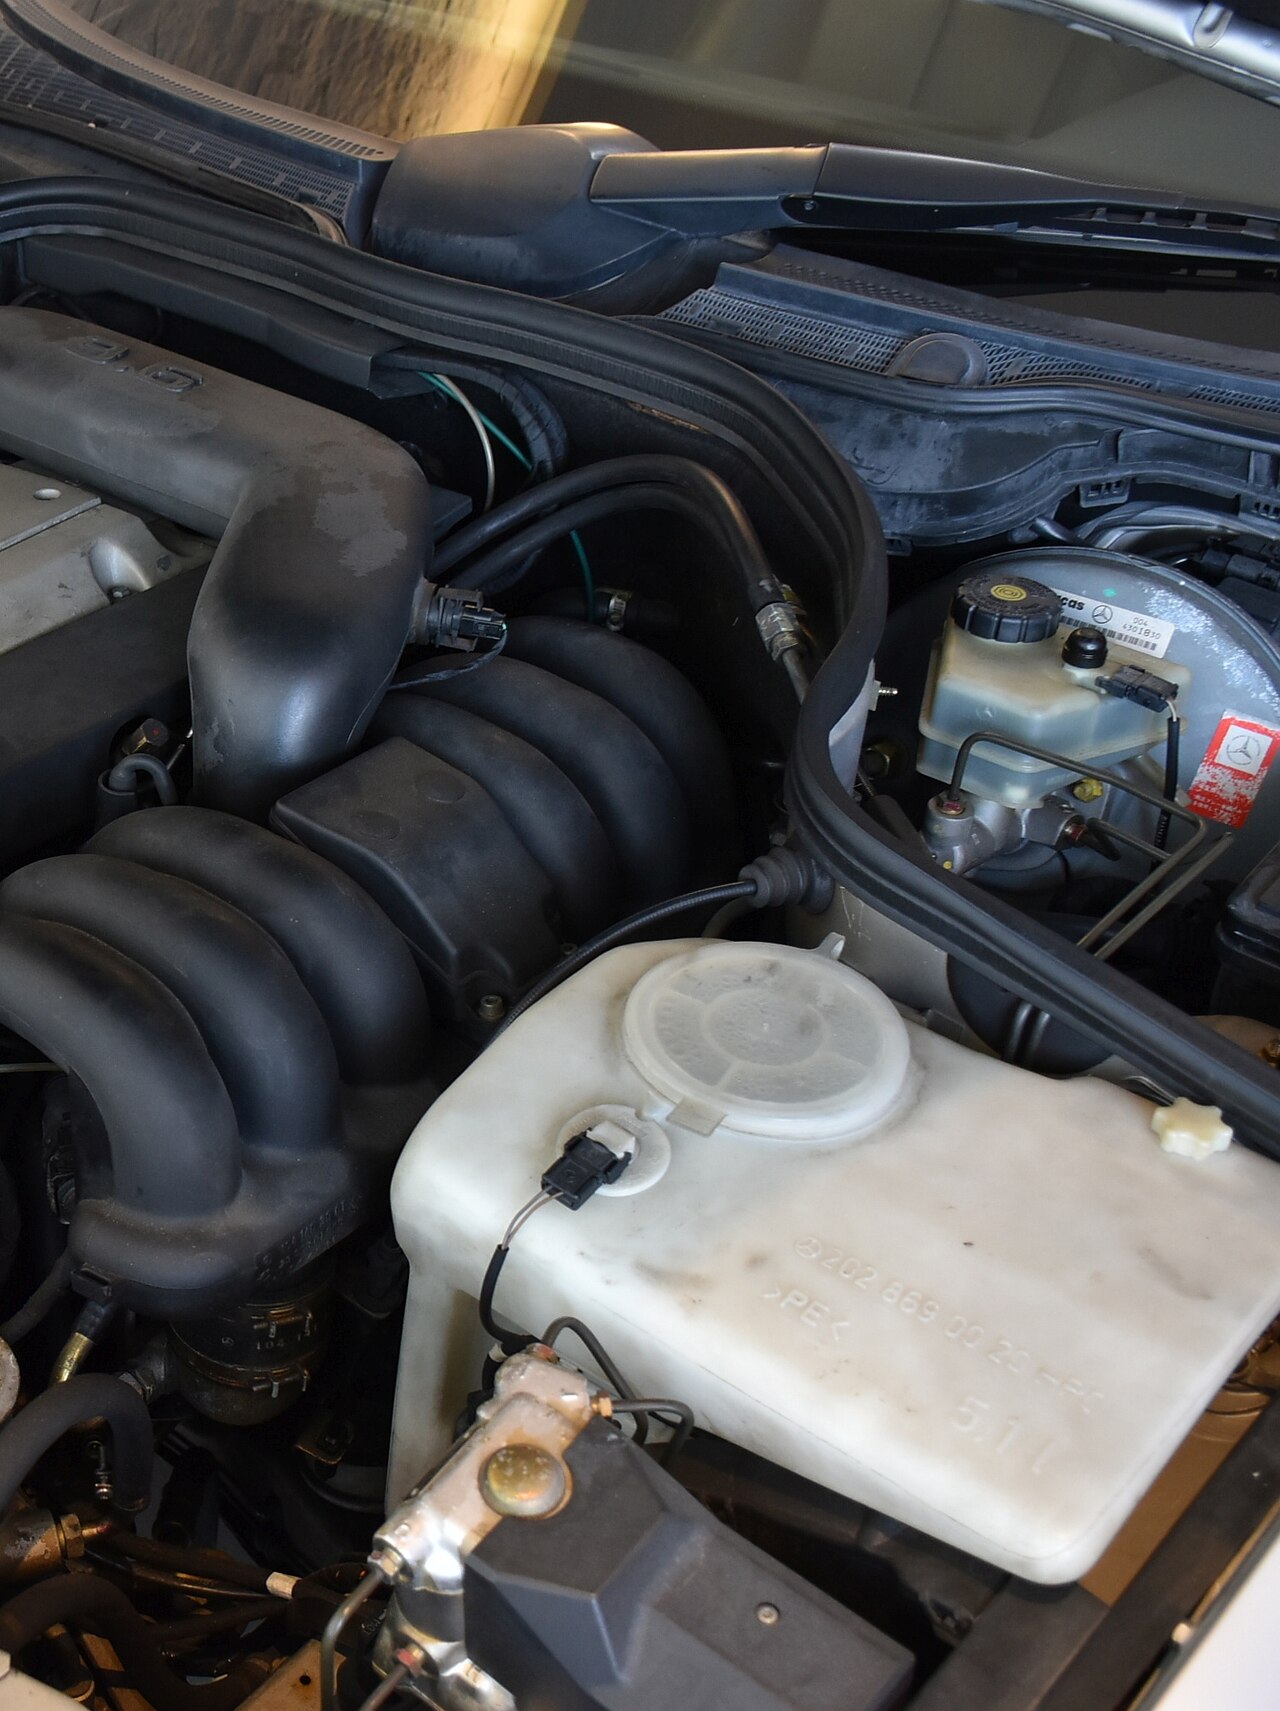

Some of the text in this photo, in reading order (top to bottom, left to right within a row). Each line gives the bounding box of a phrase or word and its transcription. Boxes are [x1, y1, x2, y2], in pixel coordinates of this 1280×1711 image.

[1058, 594, 1086, 611] cas
[1132, 616, 1149, 627] 004
[820, 1246, 879, 1291] 202
[880, 1280, 941, 1324] 869
[944, 1314, 986, 1349] 00
